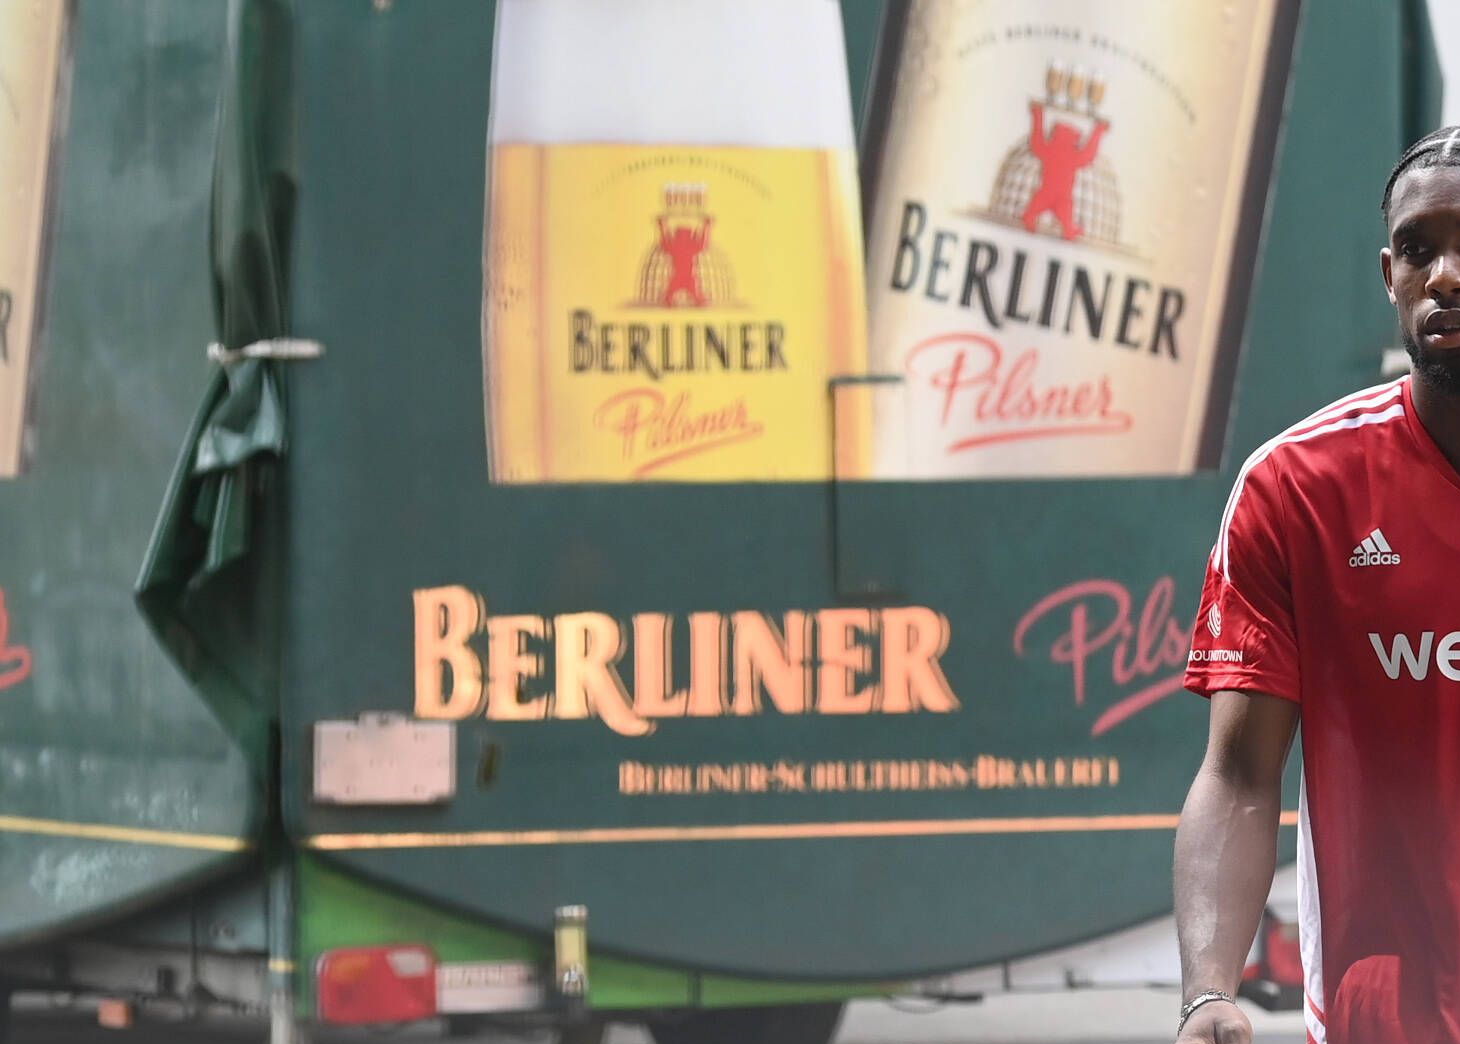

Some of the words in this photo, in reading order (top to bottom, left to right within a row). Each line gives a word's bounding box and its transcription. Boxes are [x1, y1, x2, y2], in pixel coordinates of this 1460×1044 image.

[891, 201, 1187, 361] BERLINER
[570, 309, 788, 380] BERLINER
[904, 332, 1134, 455] Pilsner
[1349, 551, 1401, 567] adidas
[412, 585, 960, 737] BERLINER
